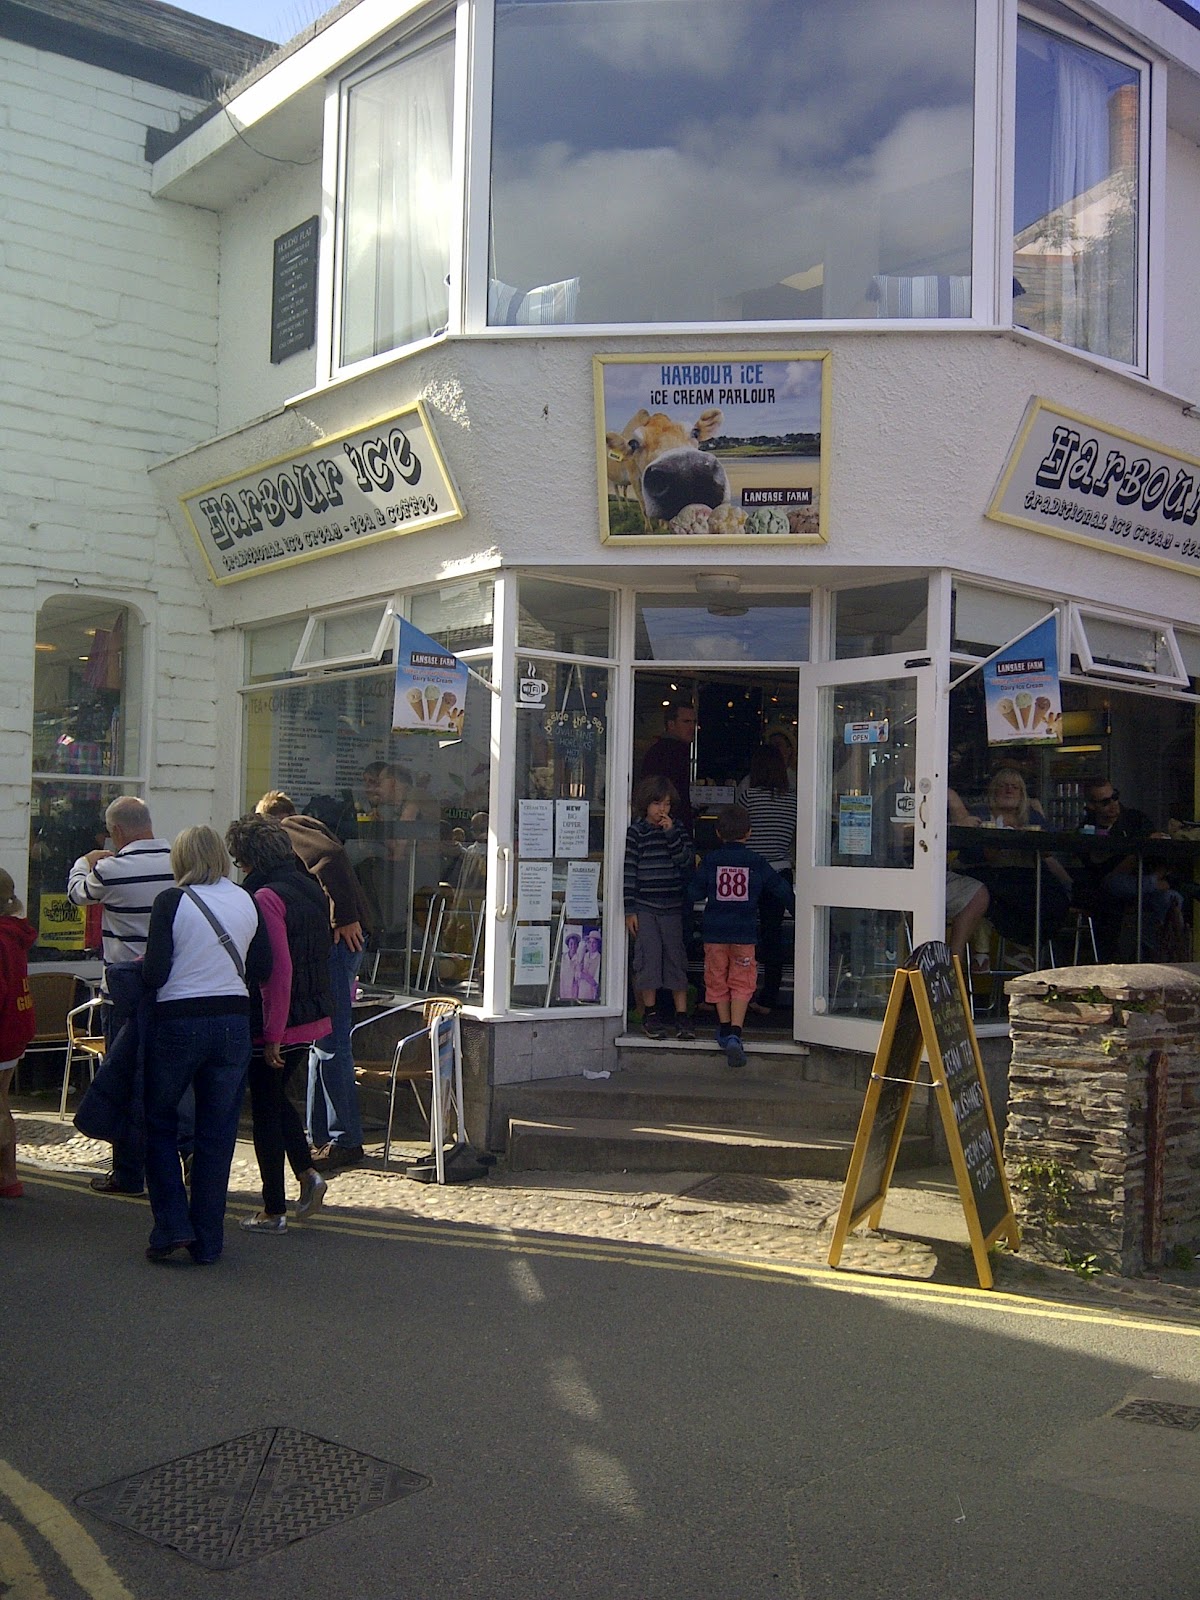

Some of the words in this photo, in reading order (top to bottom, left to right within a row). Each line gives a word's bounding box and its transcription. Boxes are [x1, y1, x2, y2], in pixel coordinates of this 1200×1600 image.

[661, 364, 733, 386] HARBOUR
[673, 389, 715, 405] CREAM
[718, 387, 776, 405] PARLOUR
[786, 490, 810, 502] FARM
[717, 872, 747, 897] 88
[48, 909, 81, 922] SCHOOL
